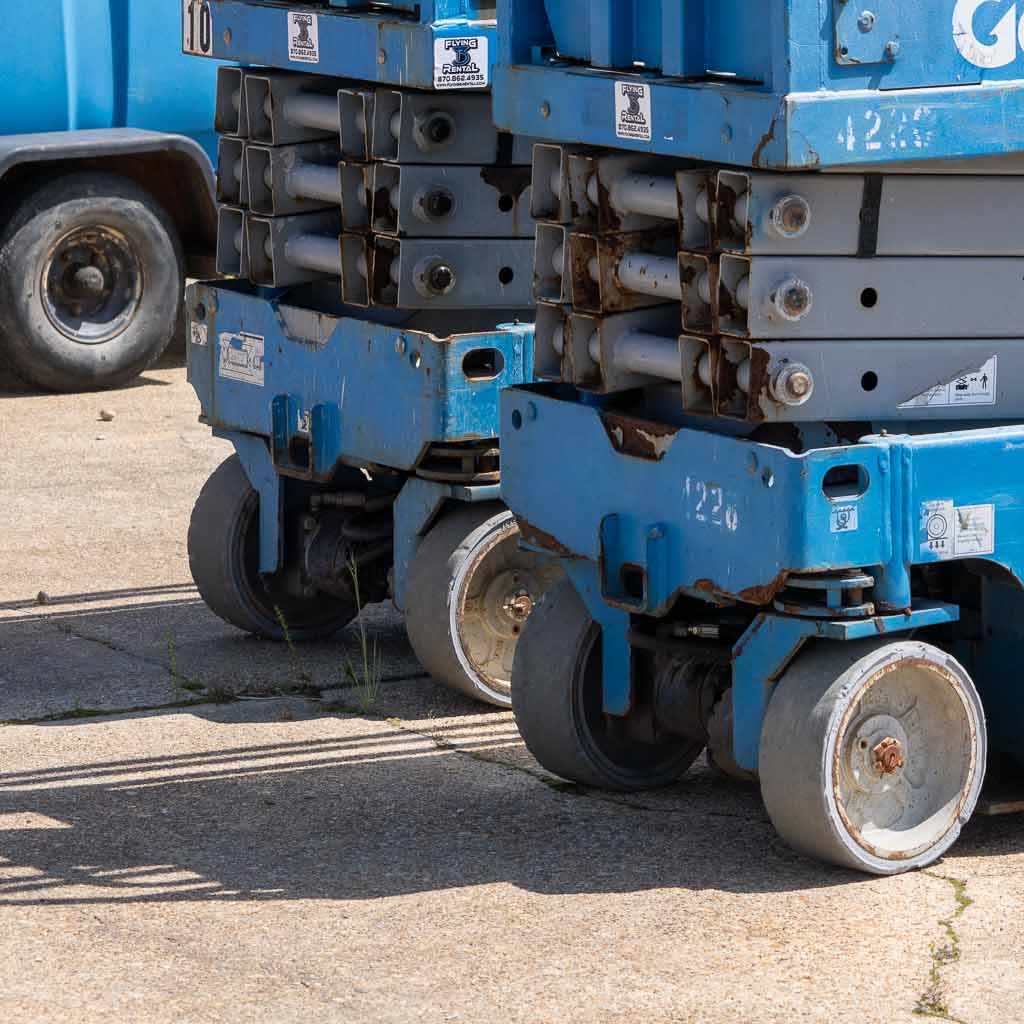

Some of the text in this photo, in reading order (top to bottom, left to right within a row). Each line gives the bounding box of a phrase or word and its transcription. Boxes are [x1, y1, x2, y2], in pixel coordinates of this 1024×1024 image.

[188, 0, 211, 54] 10
[445, 39, 478, 49] FLYING
[442, 63, 480, 74] RENTAL
[621, 84, 645, 98] FLYING
[621, 111, 646, 125] RENTAL
